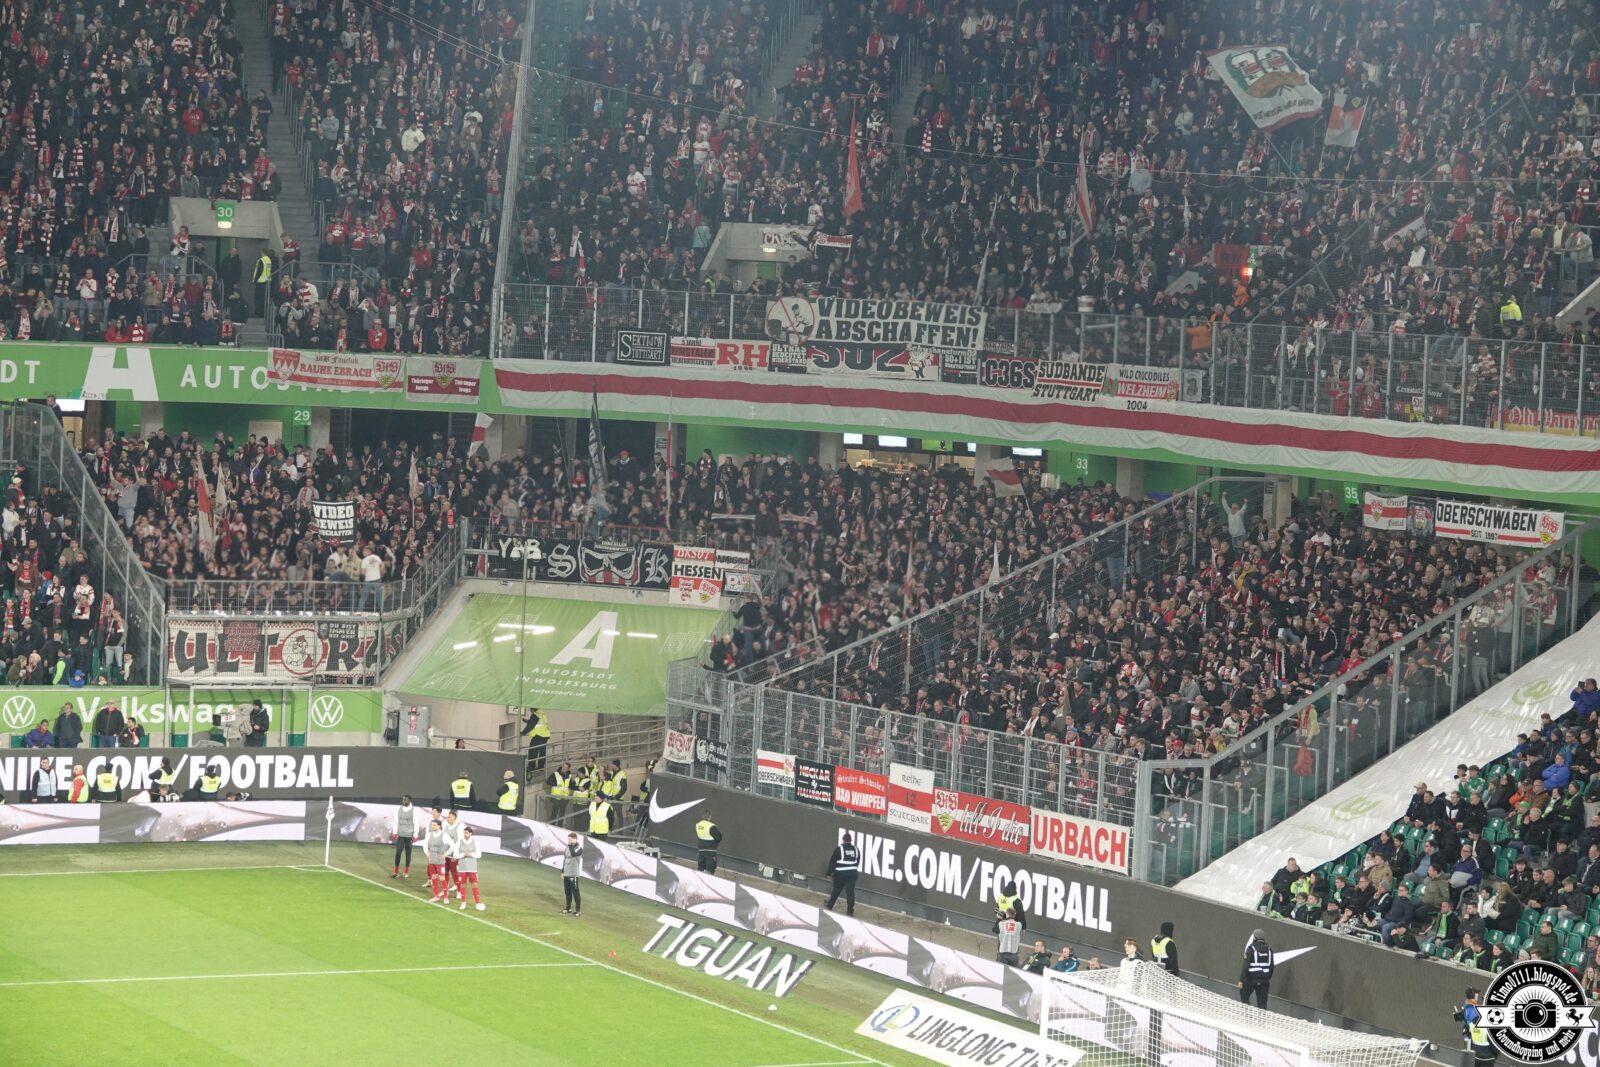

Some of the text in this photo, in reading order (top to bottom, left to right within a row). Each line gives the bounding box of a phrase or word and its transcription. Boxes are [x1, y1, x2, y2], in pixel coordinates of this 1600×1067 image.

[217, 207, 233, 217] 30
[817, 297, 982, 326] VIDEOBEWEIS
[815, 319, 979, 347] ABSCHAFFEN!
[717, 343, 769, 367] RH
[300, 363, 372, 378] RAUHE EBRACH
[1119, 369, 1170, 382] WILD CROCODILES
[1032, 383, 1101, 402] STUTTGART
[1117, 382, 1167, 397] WELZHEIM
[1126, 400, 1148, 410] 2004
[294, 410, 310, 421] 29
[1509, 406, 1533, 426] Old
[1076, 458, 1088, 469] 33
[1345, 487, 1358, 499] 35
[313, 504, 354, 519] VIDEO
[1436, 502, 1538, 532] OBERSCHWABEN
[1471, 529, 1482, 539] SEIT
[673, 564, 721, 580] HESSEN
[532, 667, 616, 681] AUTOSTADT
[535, 677, 617, 690] WOLFSBURG
[799, 765, 831, 781] NECKAR
[797, 786, 832, 802] HALUNKEN
[835, 787, 886, 811] BAD WIMPFEN
[1033, 814, 1127, 868] URBACH
[642, 913, 812, 998] TIGUAN
[906, 1014, 1017, 1067] LINGLONG
